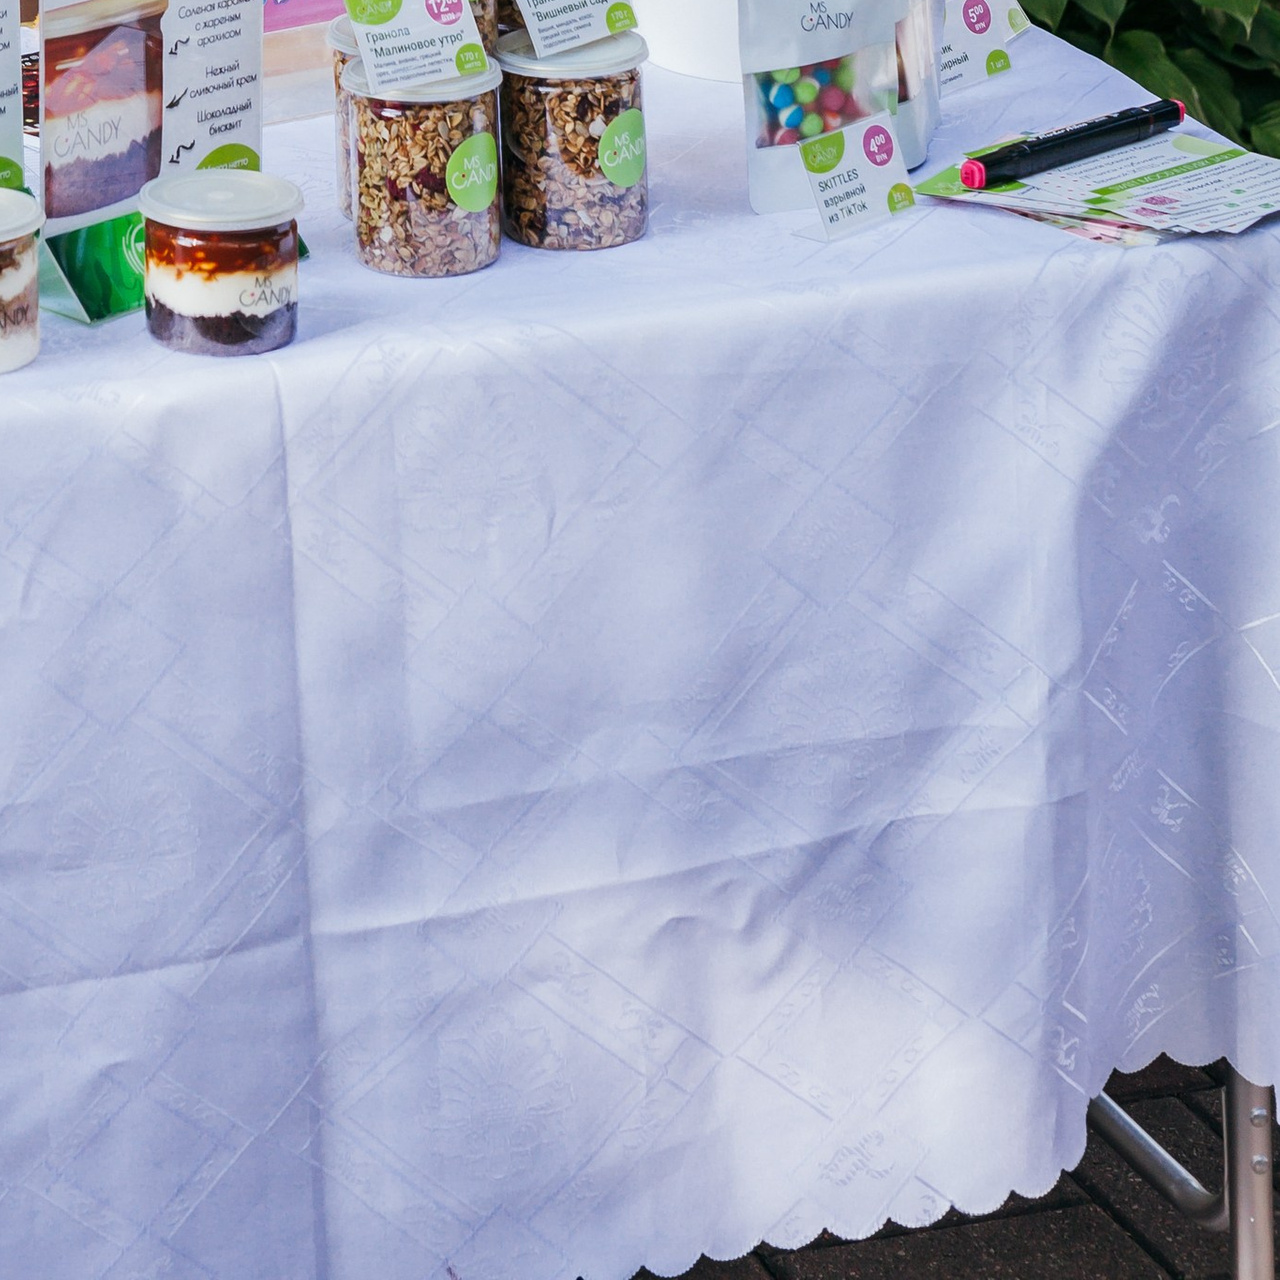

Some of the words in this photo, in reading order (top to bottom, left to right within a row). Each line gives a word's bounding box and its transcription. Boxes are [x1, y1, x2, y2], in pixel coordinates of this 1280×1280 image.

[810, 1, 827, 15] MS
[202, 12, 241, 30] жареным
[800, 11, 854, 32] CANDY
[365, 27, 411, 44] Гранола
[205, 60, 240, 79] Нежный
[189, 77, 235, 100] сливочный
[197, 98, 253, 124] Шоколадный
[818, 168, 859, 193] SKITTLES
[824, 183, 867, 209] взрывной
[829, 213, 840, 224] из
[840, 200, 869, 220] TikTok
